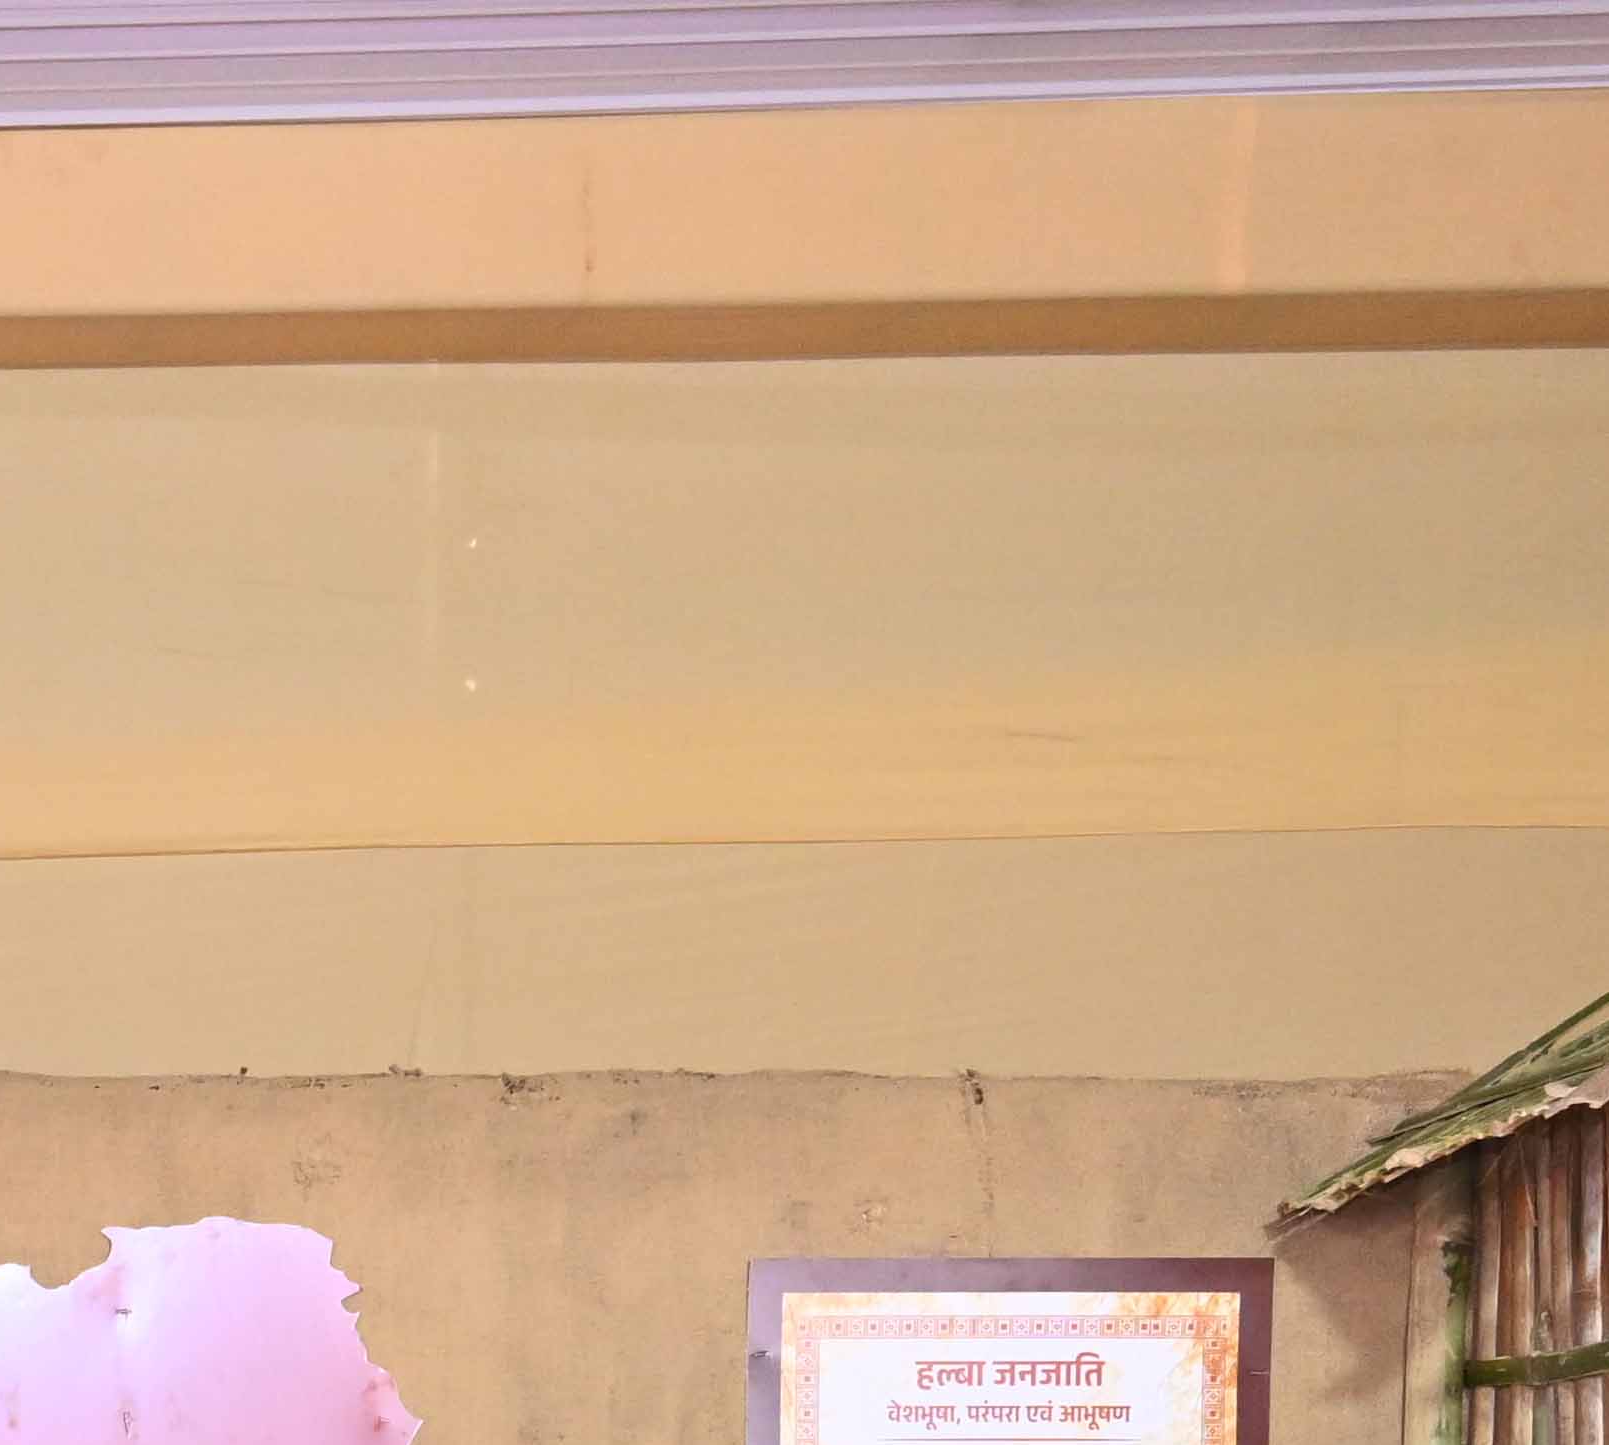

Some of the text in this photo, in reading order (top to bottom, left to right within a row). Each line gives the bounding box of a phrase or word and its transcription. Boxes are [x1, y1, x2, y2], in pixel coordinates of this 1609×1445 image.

[915, 1352, 1105, 1389] हल्बा जनजाति
[887, 1400, 1132, 1430] वेशभूषा, परंपरा एवं आभूषण
